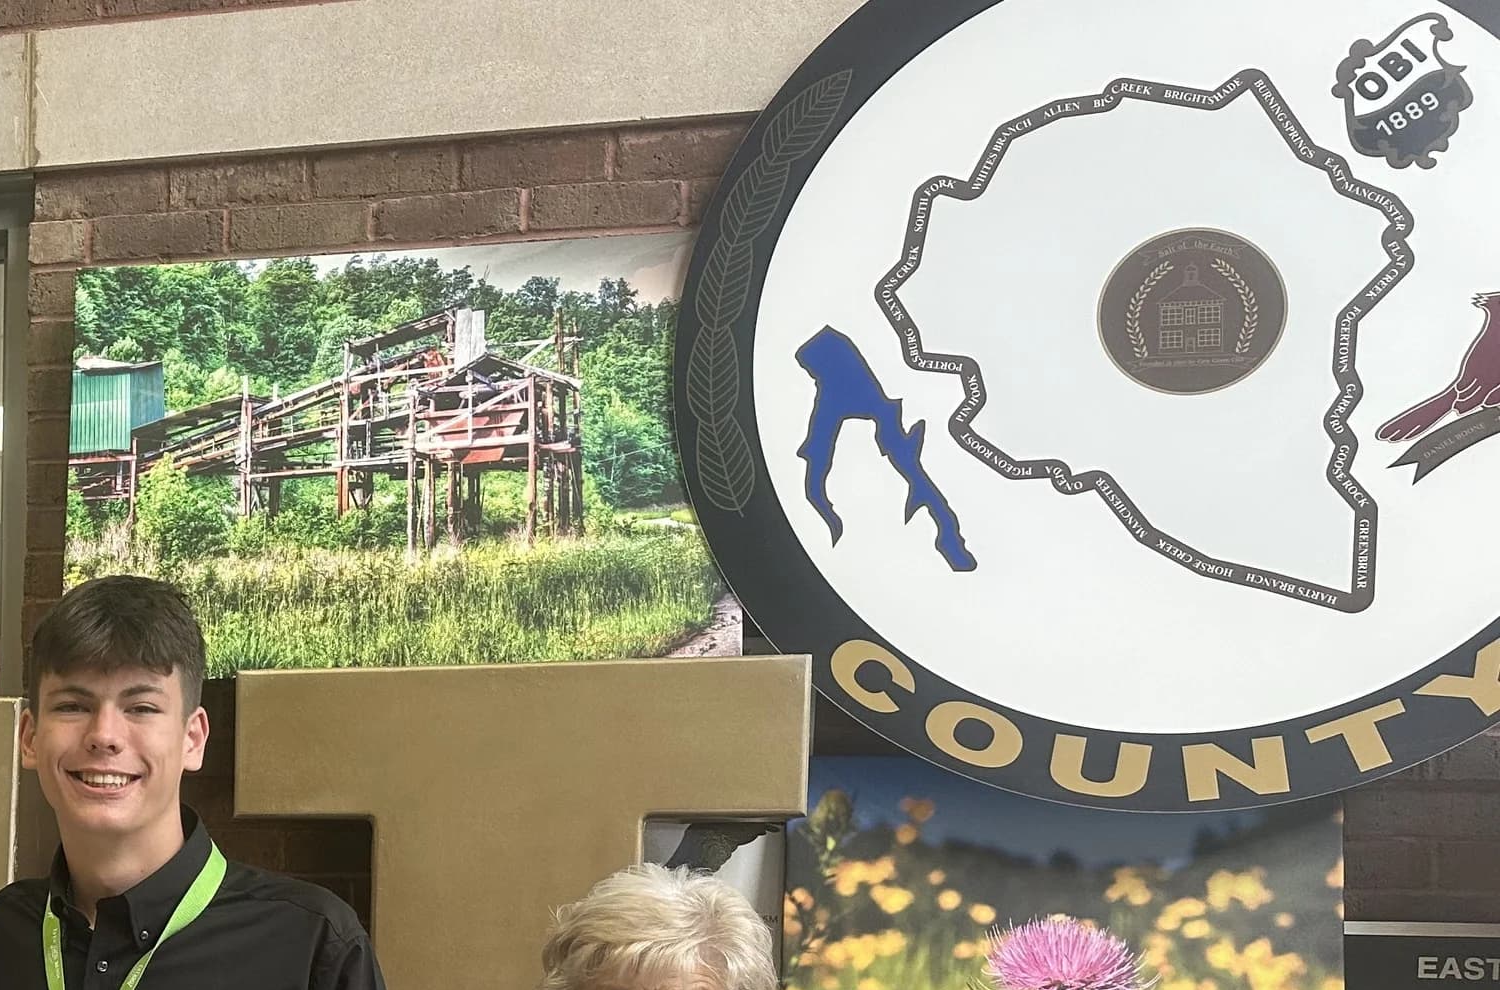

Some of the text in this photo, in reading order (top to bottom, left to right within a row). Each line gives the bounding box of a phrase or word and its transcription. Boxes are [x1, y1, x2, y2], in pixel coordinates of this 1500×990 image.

[1093, 82, 1152, 109] BIG CREEK
[1163, 77, 1243, 105] BRIGHTSHADE
[1355, 38, 1428, 101] OBI
[1042, 101, 1081, 120] ALLEN
[1254, 78, 1316, 160] BURNING SPRINGS
[1375, 92, 1440, 136] 1889
[971, 117, 1033, 190] WHITES BRANCH
[913, 179, 957, 233] SOUTH FORK
[1324, 157, 1406, 232] EAST MANCHESTER
[881, 245, 920, 322] SEXTONS CREEK
[1364, 240, 1407, 301] FLAT CREEK
[904, 327, 963, 373] PORTERSBURG
[1338, 305, 1362, 373] FOGERTOWN
[955, 374, 981, 423] PIN HOOK
[1329, 383, 1357, 435] GARRARD
[960, 432, 1032, 477] PIGEON ROOST
[1332, 444, 1370, 509] GOOSE ROCK
[1094, 476, 1149, 539] MANCHESTER
[1155, 537, 1234, 578] HORSE CREEK
[1356, 518, 1370, 590] GREENBRIAR
[1245, 572, 1338, 605] HARTS BRANCH
[830, 636, 1500, 802] COUNTY
